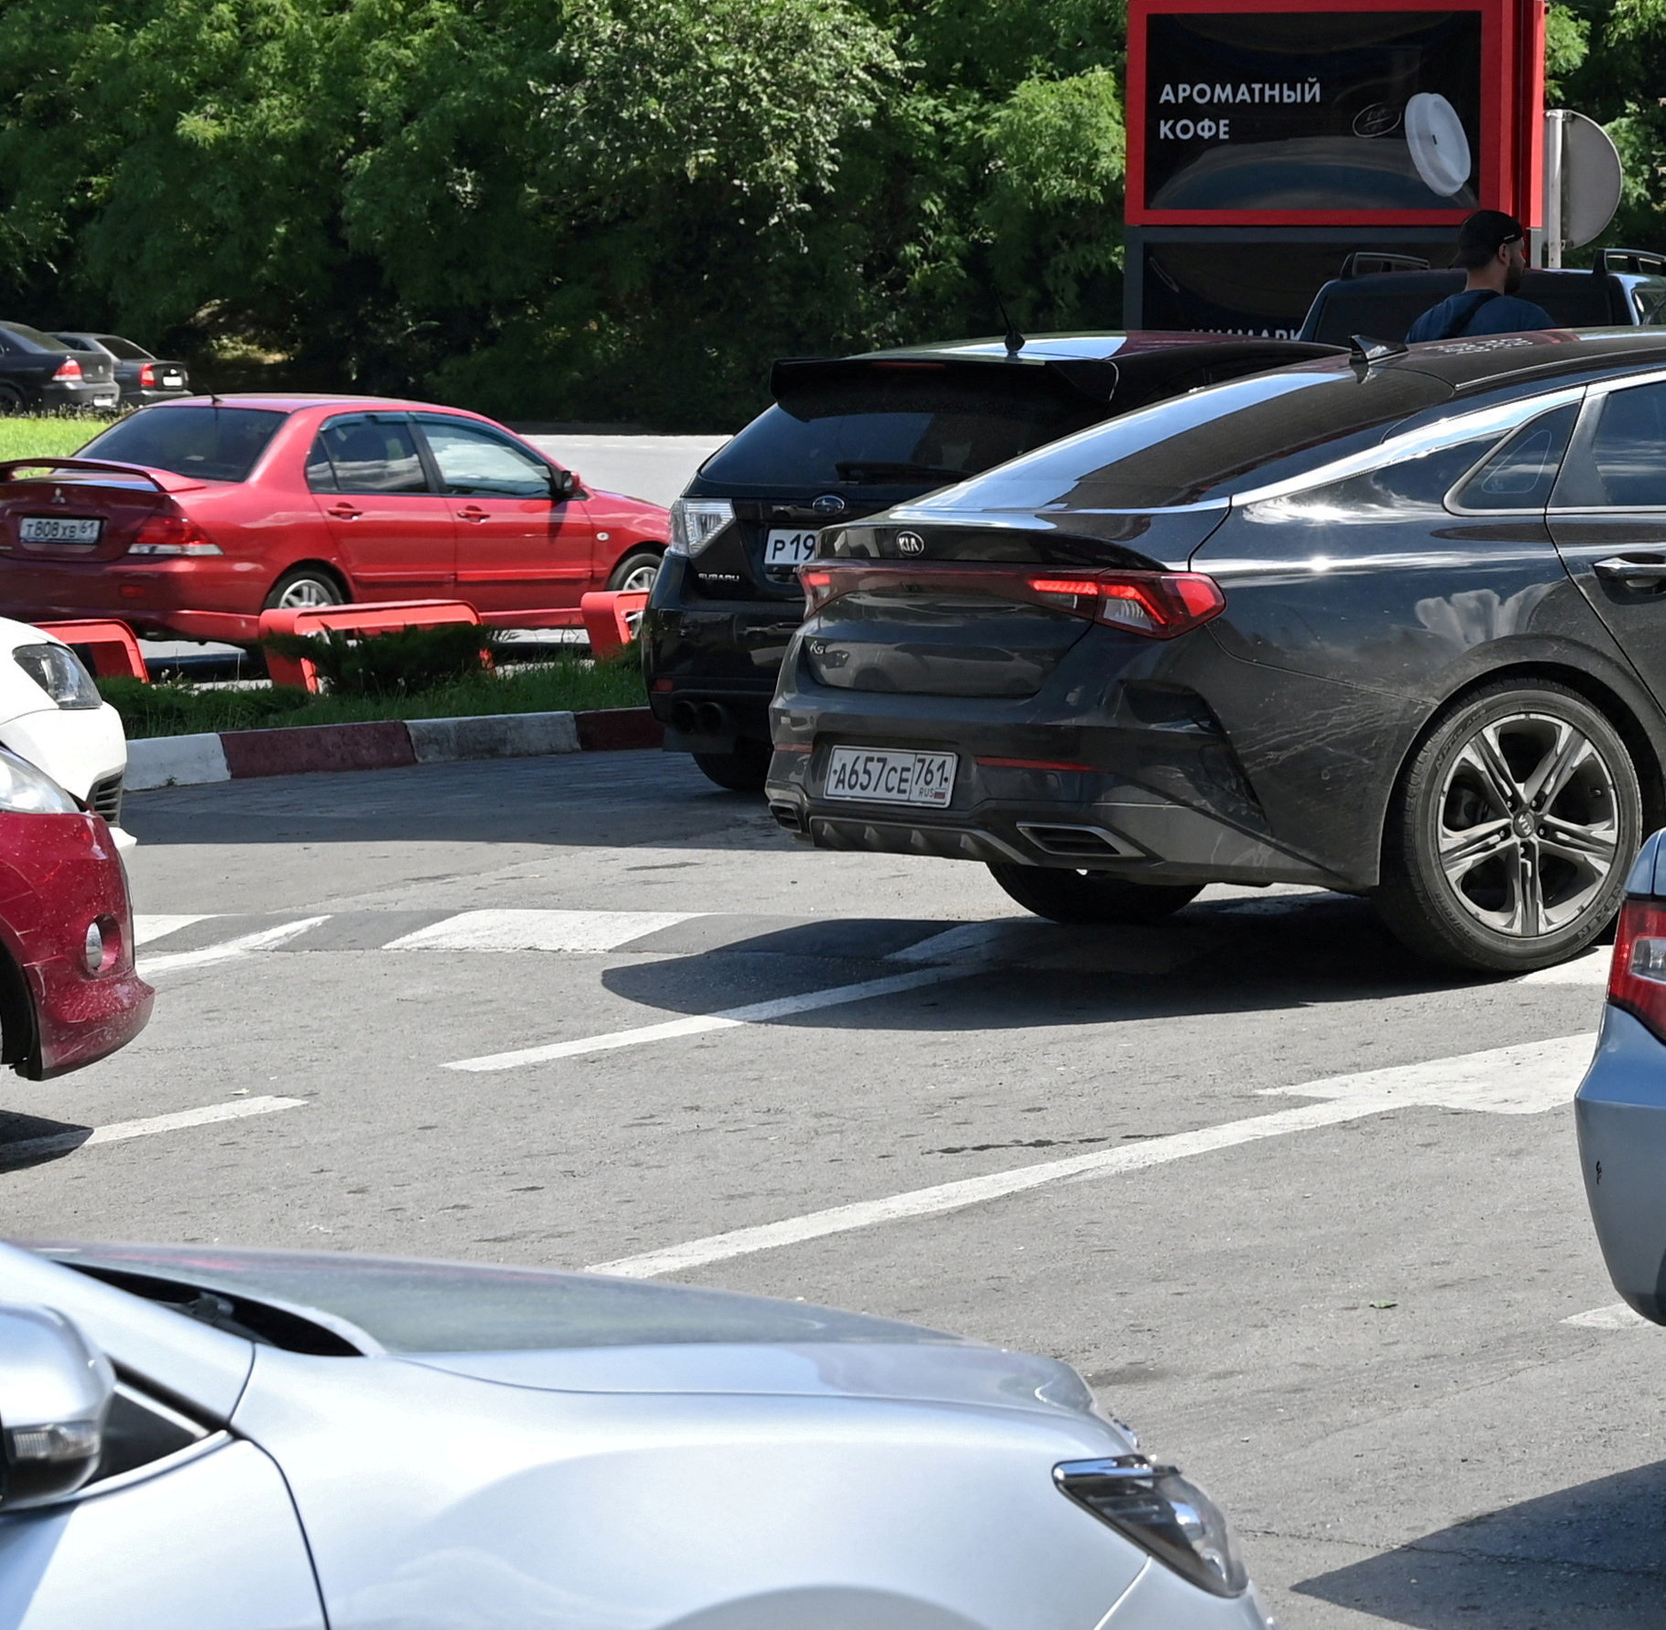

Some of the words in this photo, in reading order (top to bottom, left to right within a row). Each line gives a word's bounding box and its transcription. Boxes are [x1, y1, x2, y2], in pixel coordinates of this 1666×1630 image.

[1158, 76, 1322, 105] АРОМАТНЫЙ
[1158, 118, 1230, 141] КОФЕ
[898, 536, 919, 553] KIA
[697, 572, 741, 582] SUBARU
[834, 754, 912, 796] А657СЕ
[914, 757, 948, 788] 761
[918, 787, 935, 798] RUS
